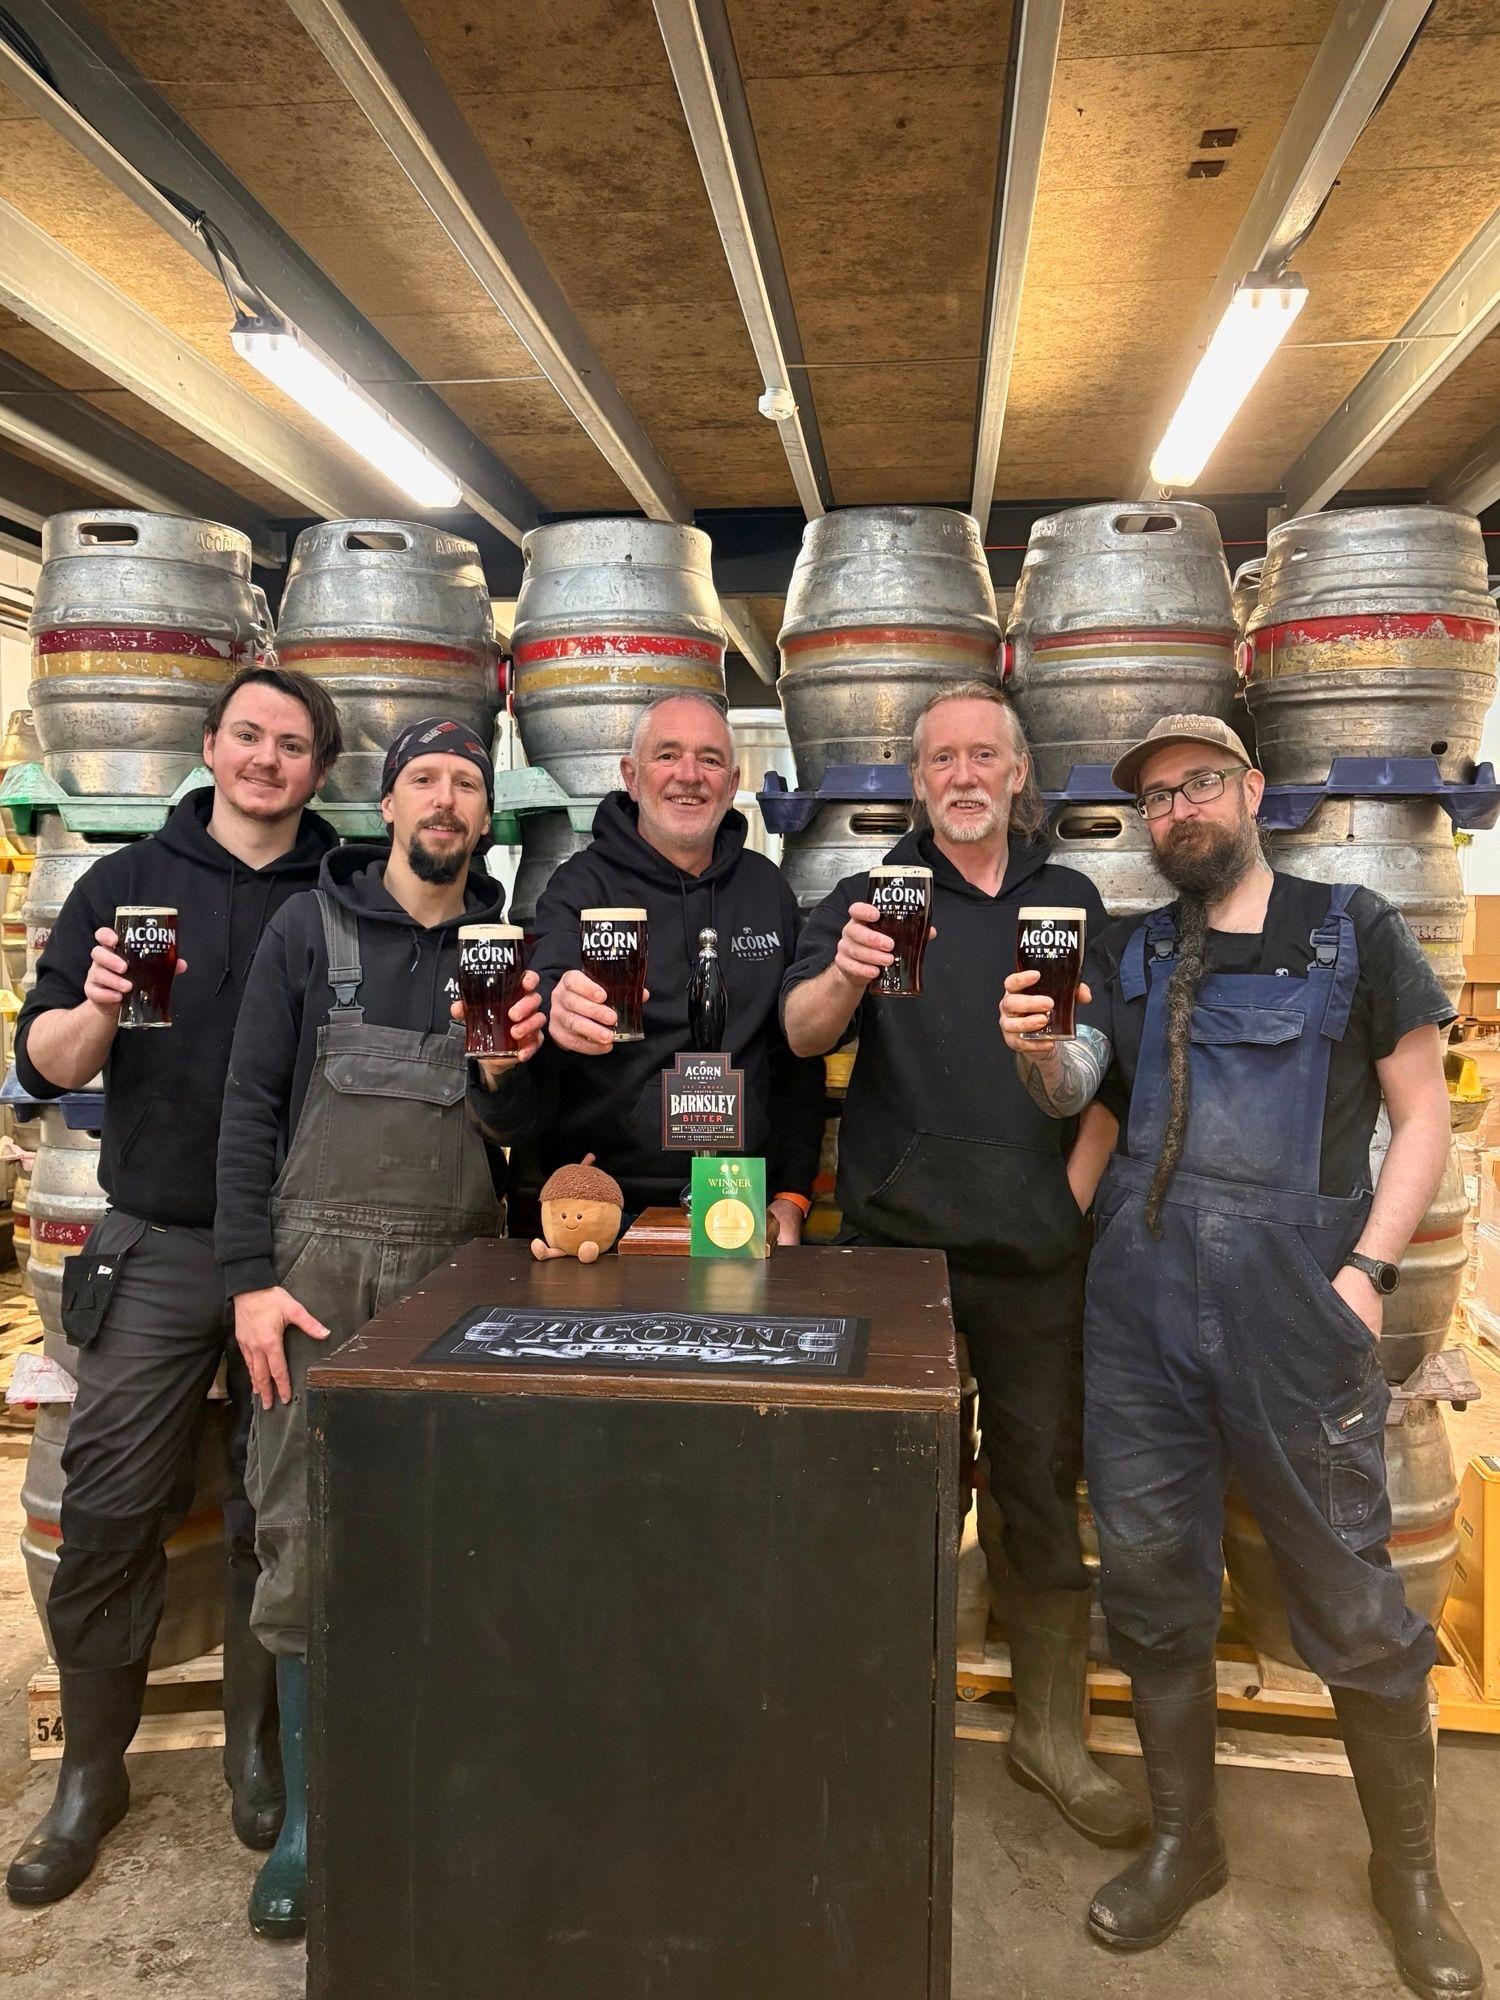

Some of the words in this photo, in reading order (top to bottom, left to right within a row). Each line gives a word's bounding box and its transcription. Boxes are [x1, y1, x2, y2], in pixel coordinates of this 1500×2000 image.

[872, 887, 925, 907] ACORN
[124, 926, 176, 946] ACORN
[582, 931, 638, 951] ACORN
[731, 931, 781, 953] ACORN
[1019, 929, 1078, 950] ACORN
[460, 946, 515, 967] ACORN
[586, 949, 630, 957] BREWERY
[1025, 947, 1071, 955] BREWERY
[684, 1065, 722, 1078] ACORN
[670, 1094, 737, 1116] BARNSLEY
[682, 1114, 723, 1123] BITTER
[708, 1178, 752, 1188] WINNER
[721, 1186, 739, 1195] Gold
[514, 1321, 786, 1351] ACORN
[570, 1344, 724, 1355] BREWERY
[37, 1716, 64, 1742] 54
